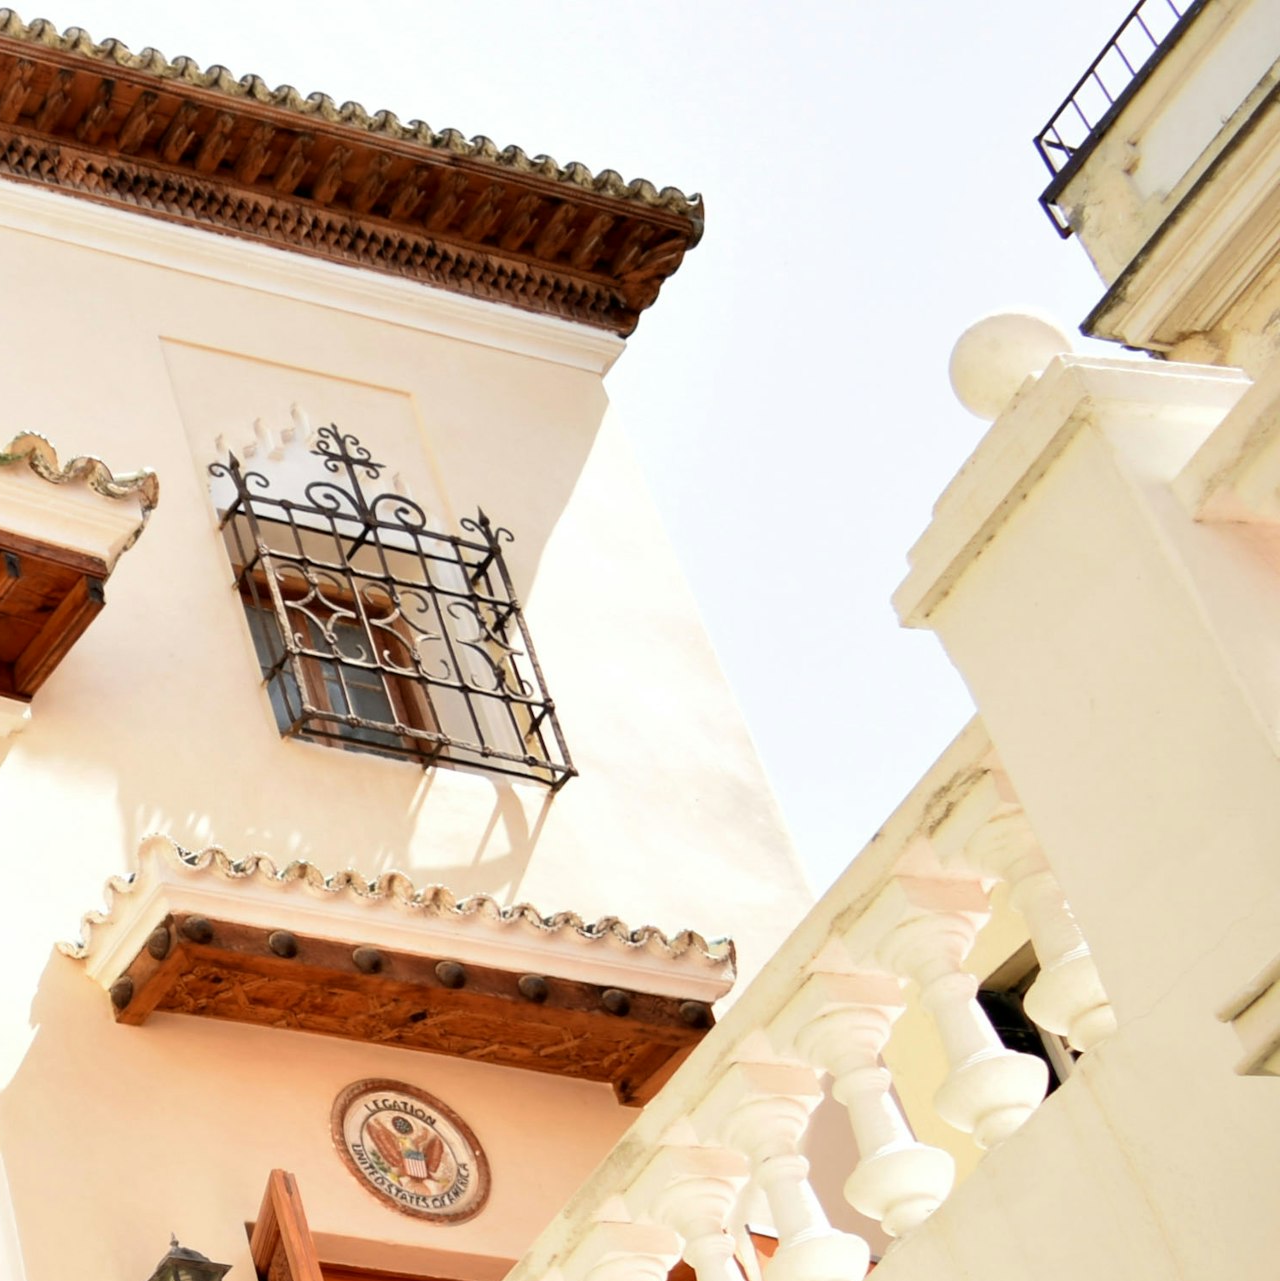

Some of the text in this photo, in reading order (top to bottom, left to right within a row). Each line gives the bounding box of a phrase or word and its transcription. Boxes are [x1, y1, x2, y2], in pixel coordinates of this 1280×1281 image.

[364, 1098, 437, 1127] LEGATION
[351, 1143, 470, 1209] UNITED STATES OF AMERICA
